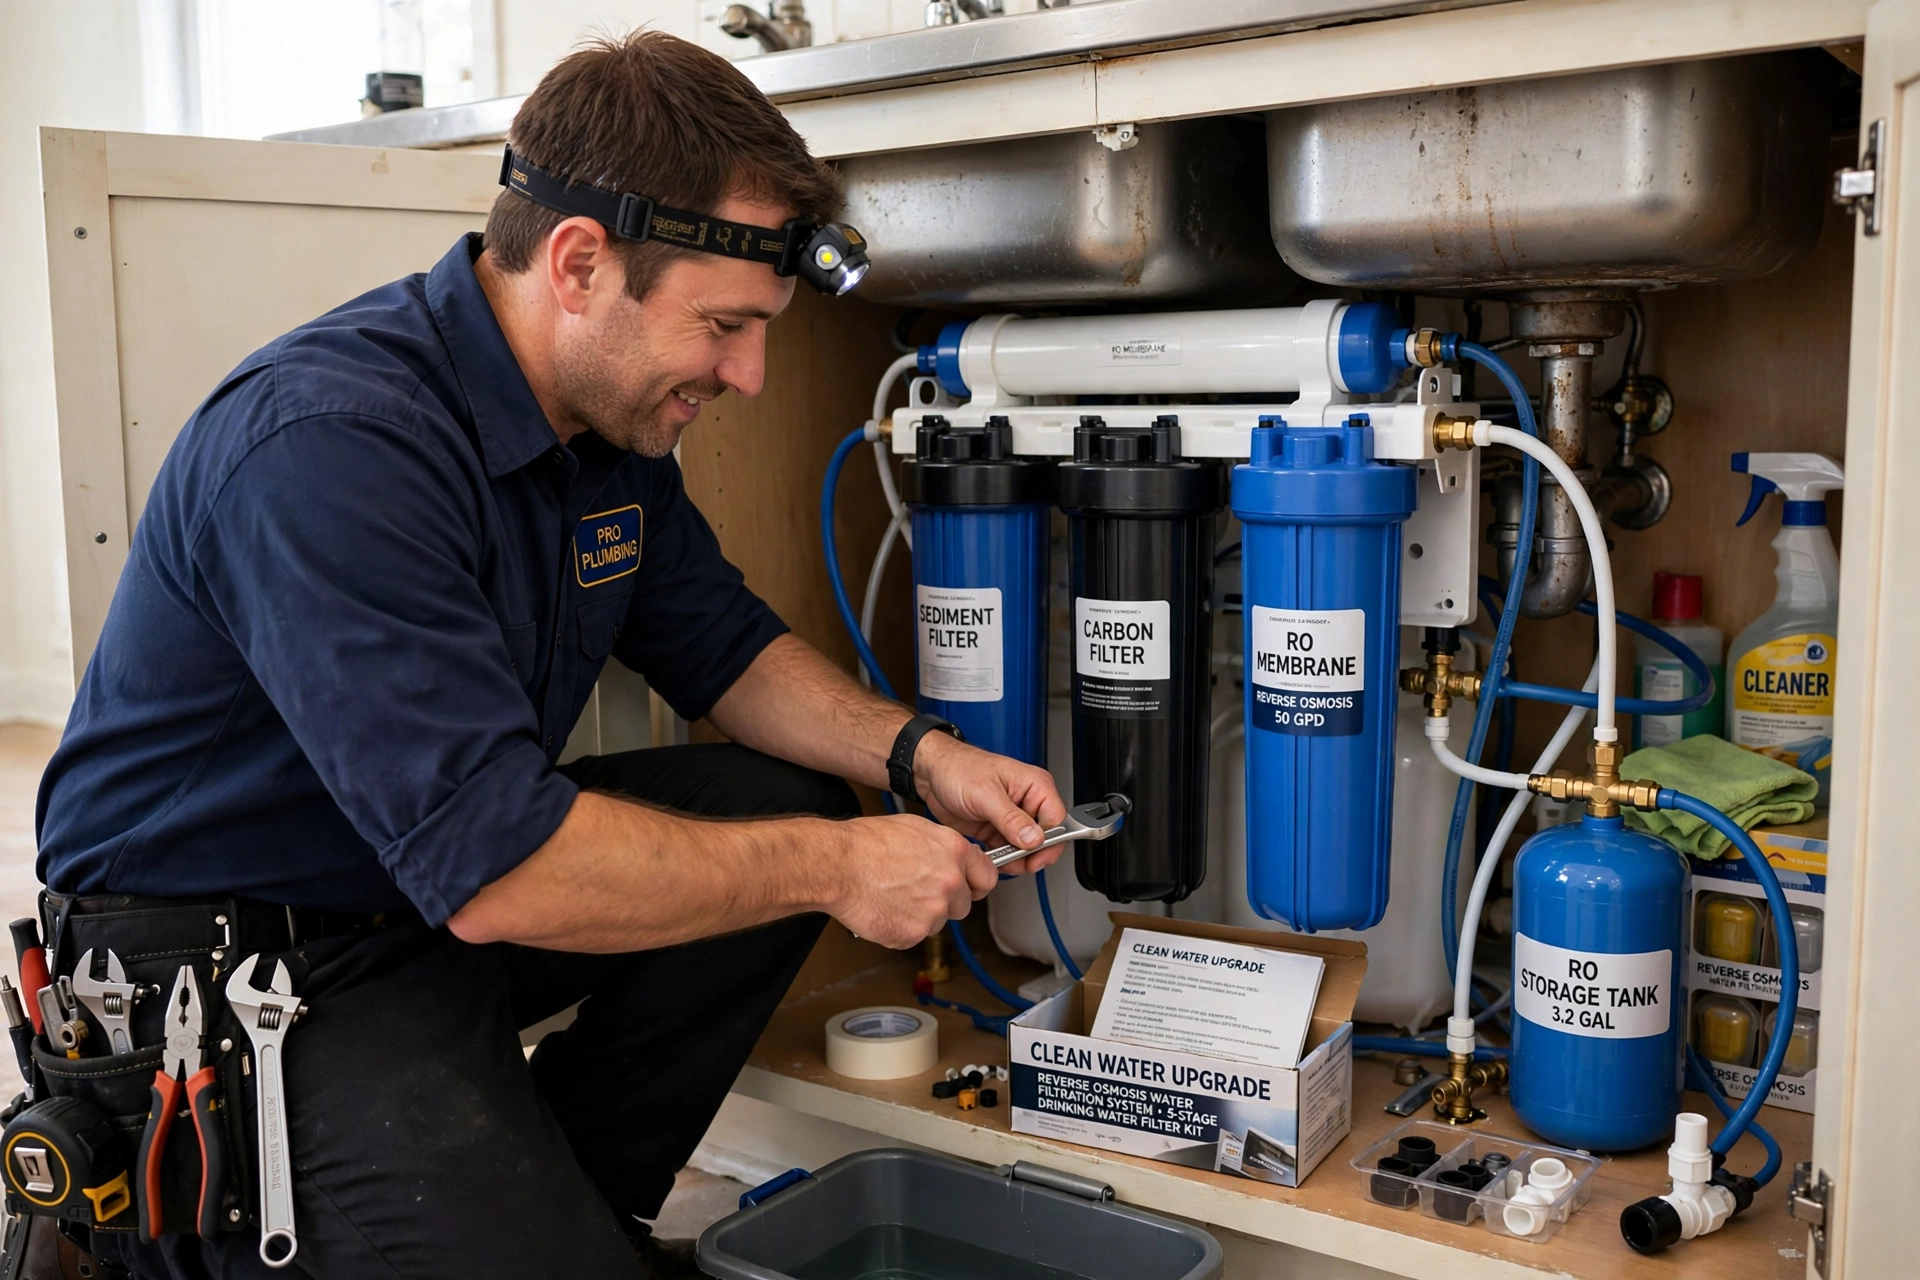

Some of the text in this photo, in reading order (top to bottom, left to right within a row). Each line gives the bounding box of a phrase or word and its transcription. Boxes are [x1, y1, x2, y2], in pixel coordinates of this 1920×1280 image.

[597, 524, 621, 545] PRO
[582, 540, 637, 570] PLUMBING
[920, 604, 994, 626] SEDIMENT
[929, 628, 978, 648] FILTER
[1084, 620, 1153, 640] CARBON
[1287, 632, 1314, 652] RO
[1090, 643, 1145, 664] FILTER
[1257, 651, 1356, 676] MEMBRANE
[1744, 669, 1829, 696] CLEANER
[1256, 690, 1353, 709] REVERSE OSMOSIS
[1275, 710, 1325, 726] 50 GPD
[1133, 943, 1266, 974] CLEAN WATER UPGRADE
[1568, 958, 1598, 981] RO
[1521, 968, 1659, 1007] STORAGE TANK
[1697, 962, 1810, 990] REVERSE OSMS
[1552, 1006, 1615, 1030] 3.2 GAL
[1030, 1041, 1271, 1100] CLEAN WATER UPGRADE
[1713, 1068, 1740, 1081] ERSE
[1038, 1072, 1194, 1110] REVERSE OSMOSIS WATER
[1038, 1086, 1218, 1126] FILTRATION SYSTEM 5-STAGE
[1038, 1098, 1094, 1118] DRINKING
[1097, 1107, 1137, 1126] WATER
[1141, 1116, 1180, 1134] FILTER
[1184, 1124, 1204, 1137] KIT
